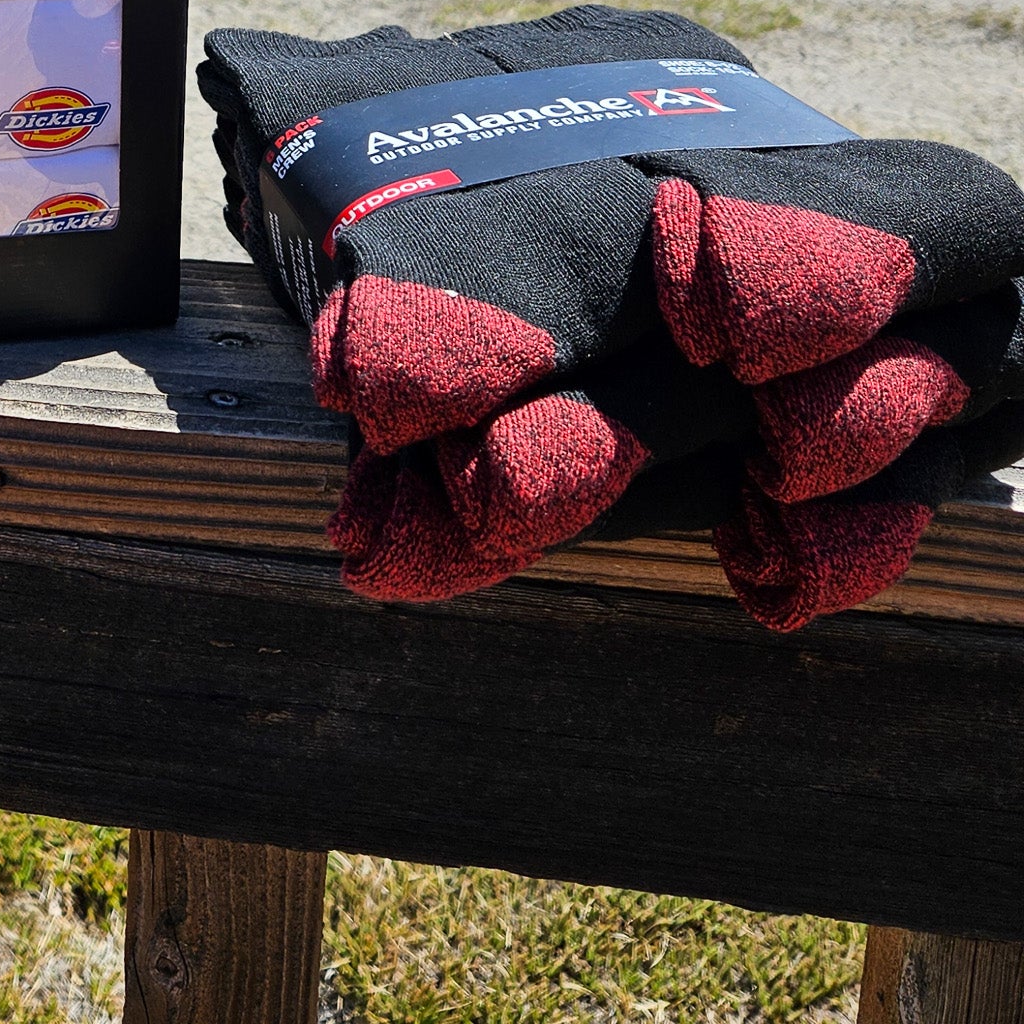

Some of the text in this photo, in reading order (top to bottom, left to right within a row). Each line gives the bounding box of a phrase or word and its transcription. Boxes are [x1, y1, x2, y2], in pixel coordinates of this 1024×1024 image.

[4, 110, 98, 129] Dickies
[274, 115, 324, 149] PACK
[366, 97, 635, 156] Avalanche
[369, 109, 644, 165] OUTDOOR SUPPLY COMPANY
[272, 129, 317, 173] MEN'S
[278, 138, 316, 180] CREW
[25, 212, 114, 235] Dickies
